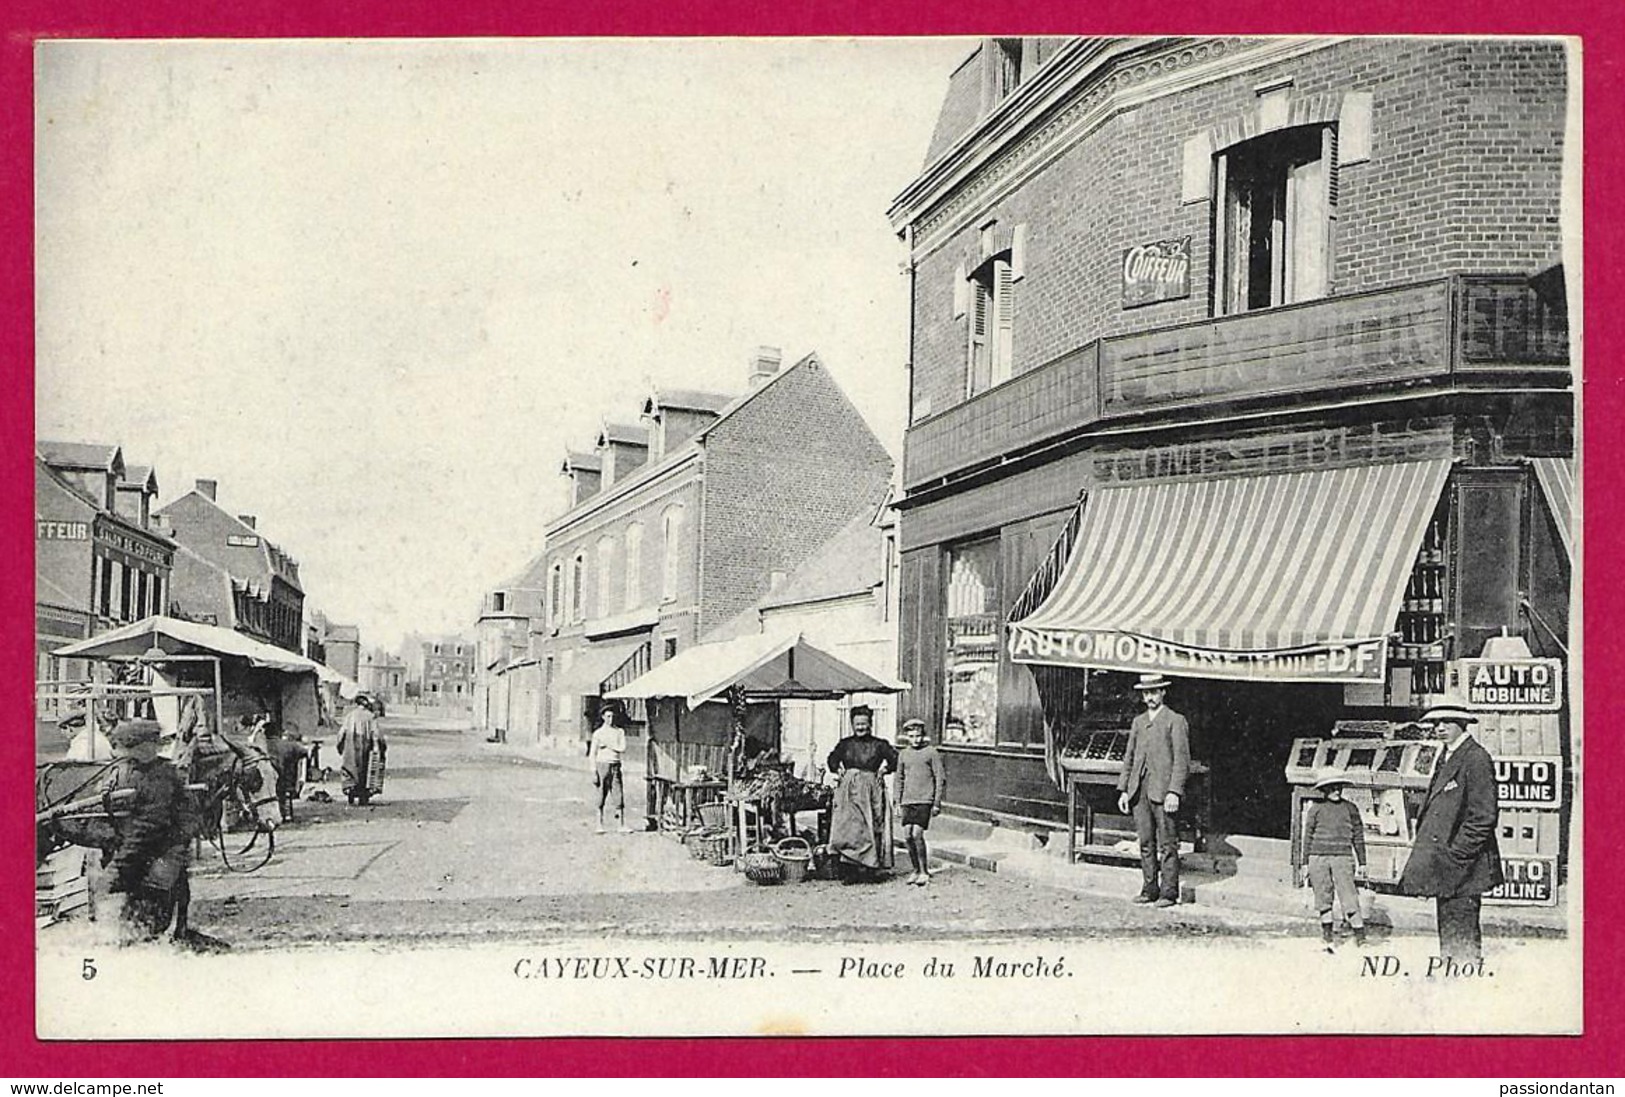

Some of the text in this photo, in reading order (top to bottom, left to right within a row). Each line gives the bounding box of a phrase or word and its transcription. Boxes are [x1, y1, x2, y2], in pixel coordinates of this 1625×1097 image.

[1474, 664, 1549, 686] AUTO
[1472, 687, 1551, 703] MOBILINE
[1494, 761, 1549, 783] UTO
[1498, 784, 1552, 800] BILINE
[1501, 860, 1544, 881] TO
[1482, 883, 1547, 899] BILINE
